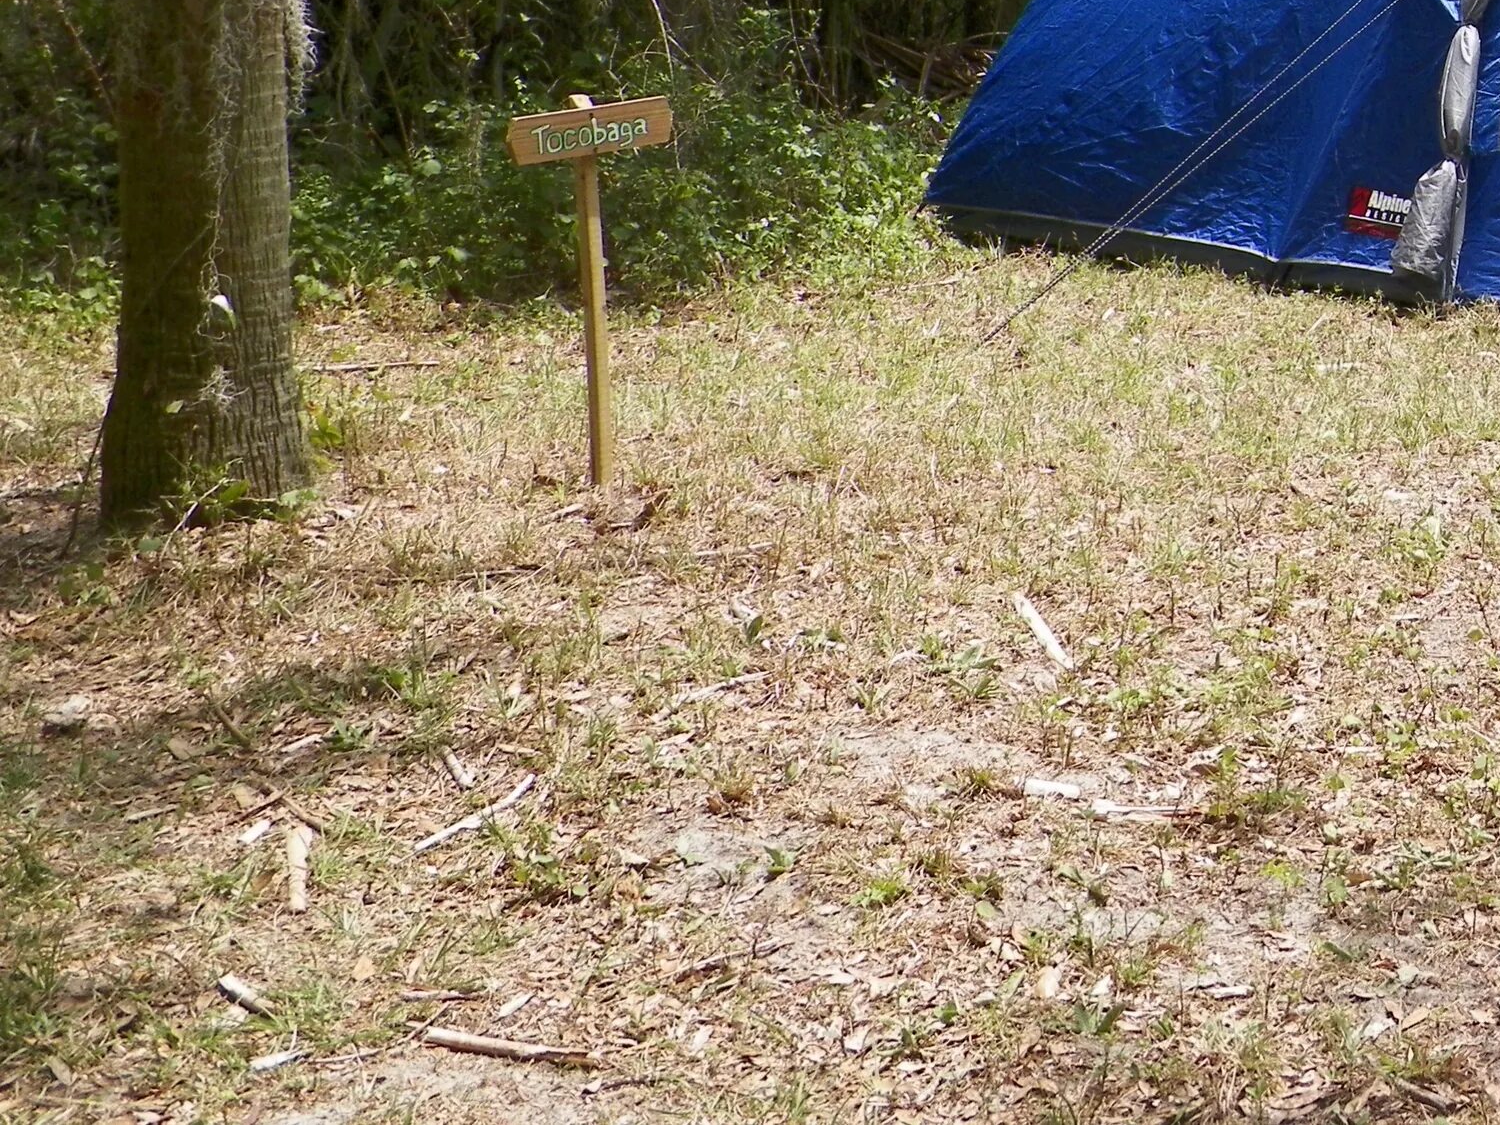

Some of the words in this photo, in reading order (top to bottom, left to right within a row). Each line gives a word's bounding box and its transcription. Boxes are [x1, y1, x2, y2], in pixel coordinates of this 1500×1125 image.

[530, 117, 648, 155] Tocobaga
[1367, 189, 1412, 214] Alpine
[1365, 208, 1407, 224] DESIG
